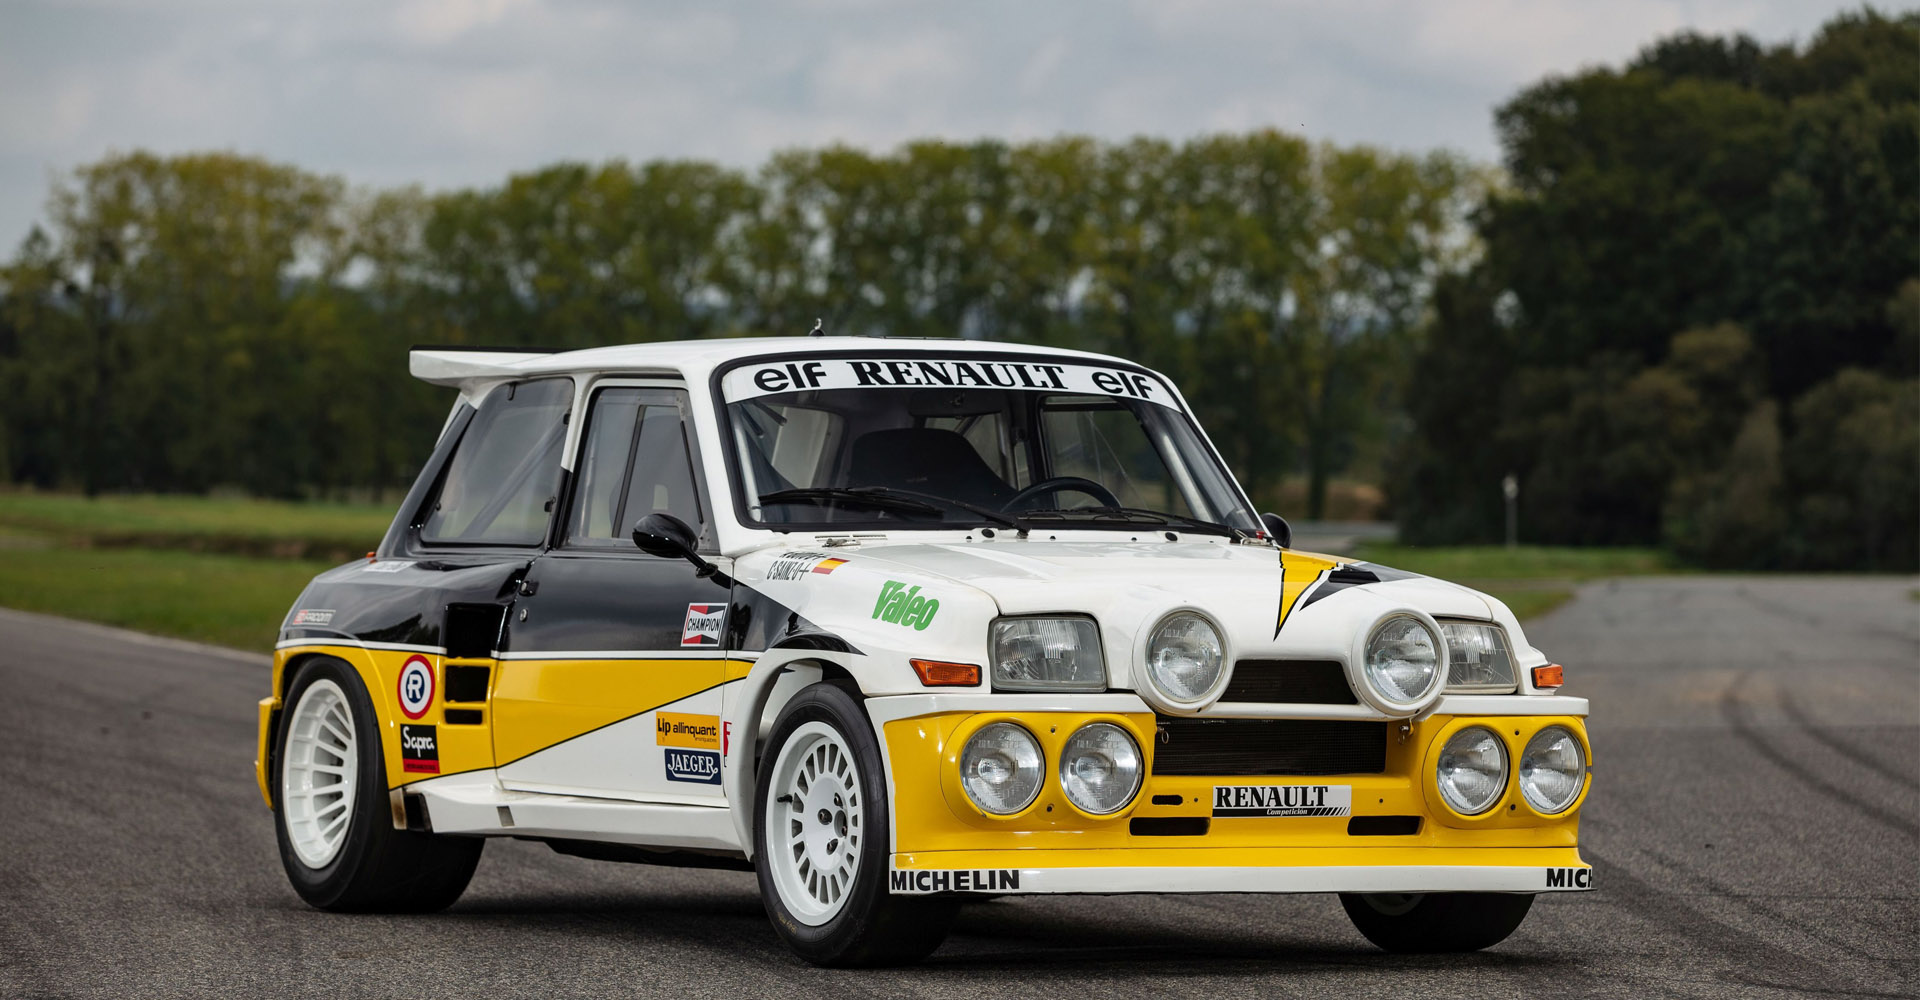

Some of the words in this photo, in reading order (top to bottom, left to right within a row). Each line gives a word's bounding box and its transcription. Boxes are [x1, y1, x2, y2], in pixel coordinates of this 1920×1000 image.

[754, 362, 827, 392] elf
[846, 361, 1069, 390] RENAULT
[1091, 371, 1153, 400] elf
[871, 579, 940, 632] Valeo
[687, 617, 722, 632] CHAMPION
[657, 718, 671, 736] Lip
[673, 722, 717, 738] allinquant
[402, 725, 436, 758] Sapra
[667, 753, 719, 774] JAEGER
[1215, 786, 1329, 807] RENAULT
[890, 869, 1020, 891] MICHELIN
